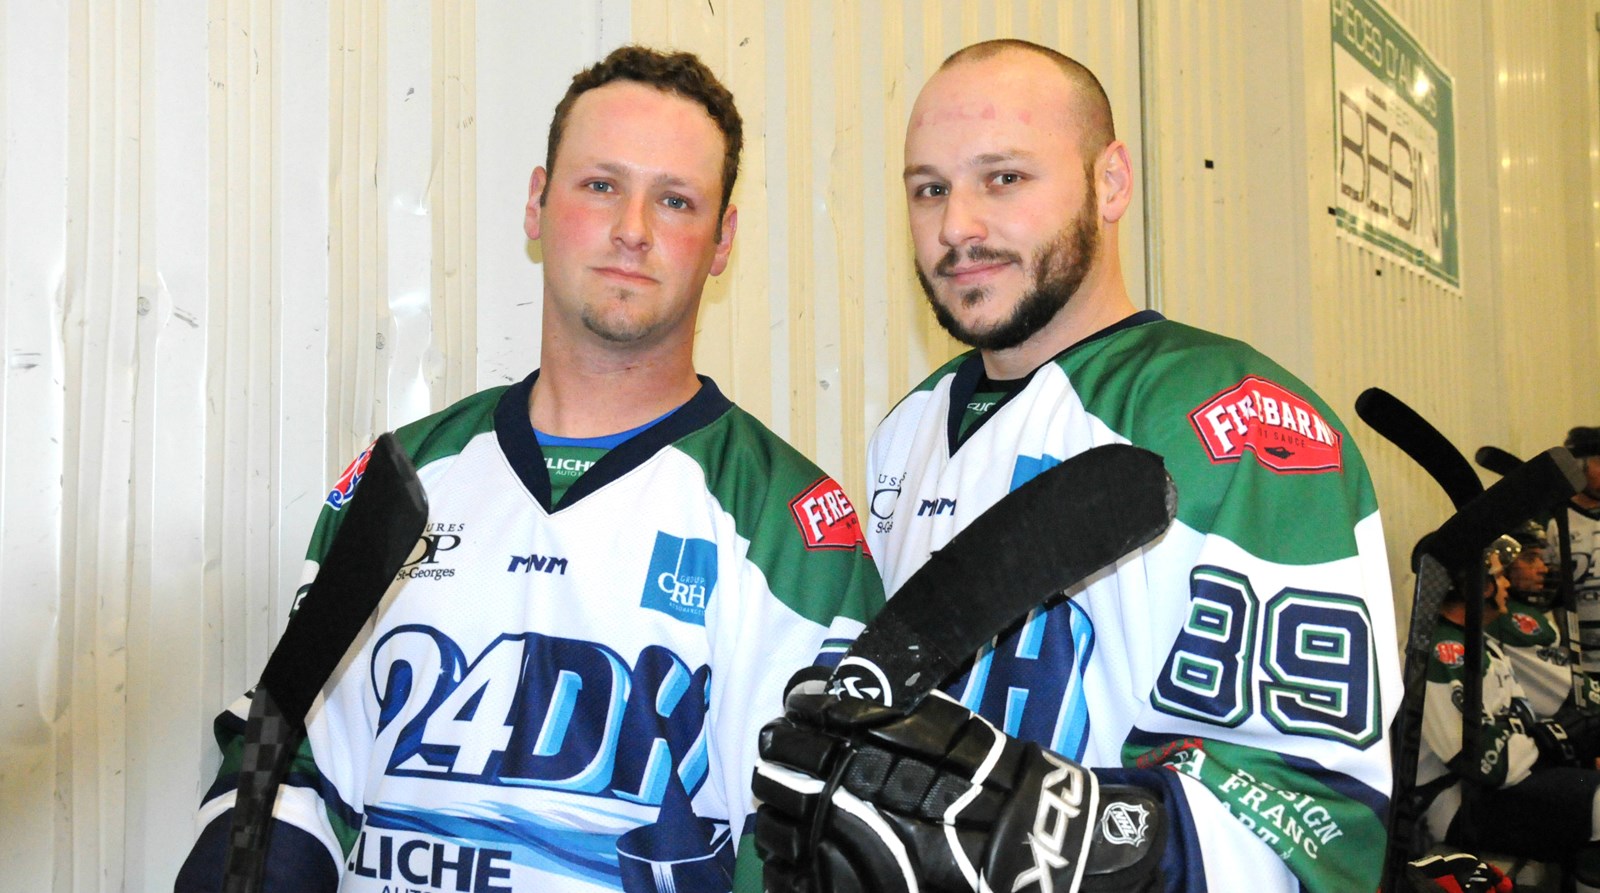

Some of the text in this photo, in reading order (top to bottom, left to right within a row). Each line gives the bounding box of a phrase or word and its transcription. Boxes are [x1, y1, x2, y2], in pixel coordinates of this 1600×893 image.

[543, 457, 597, 472] LICH
[801, 489, 854, 542] FIRE
[507, 554, 568, 575] MNM
[657, 571, 706, 610] CRH
[1150, 564, 1383, 751] 89
[1112, 810, 1136, 838] NHL
[347, 831, 513, 893] LICHE
